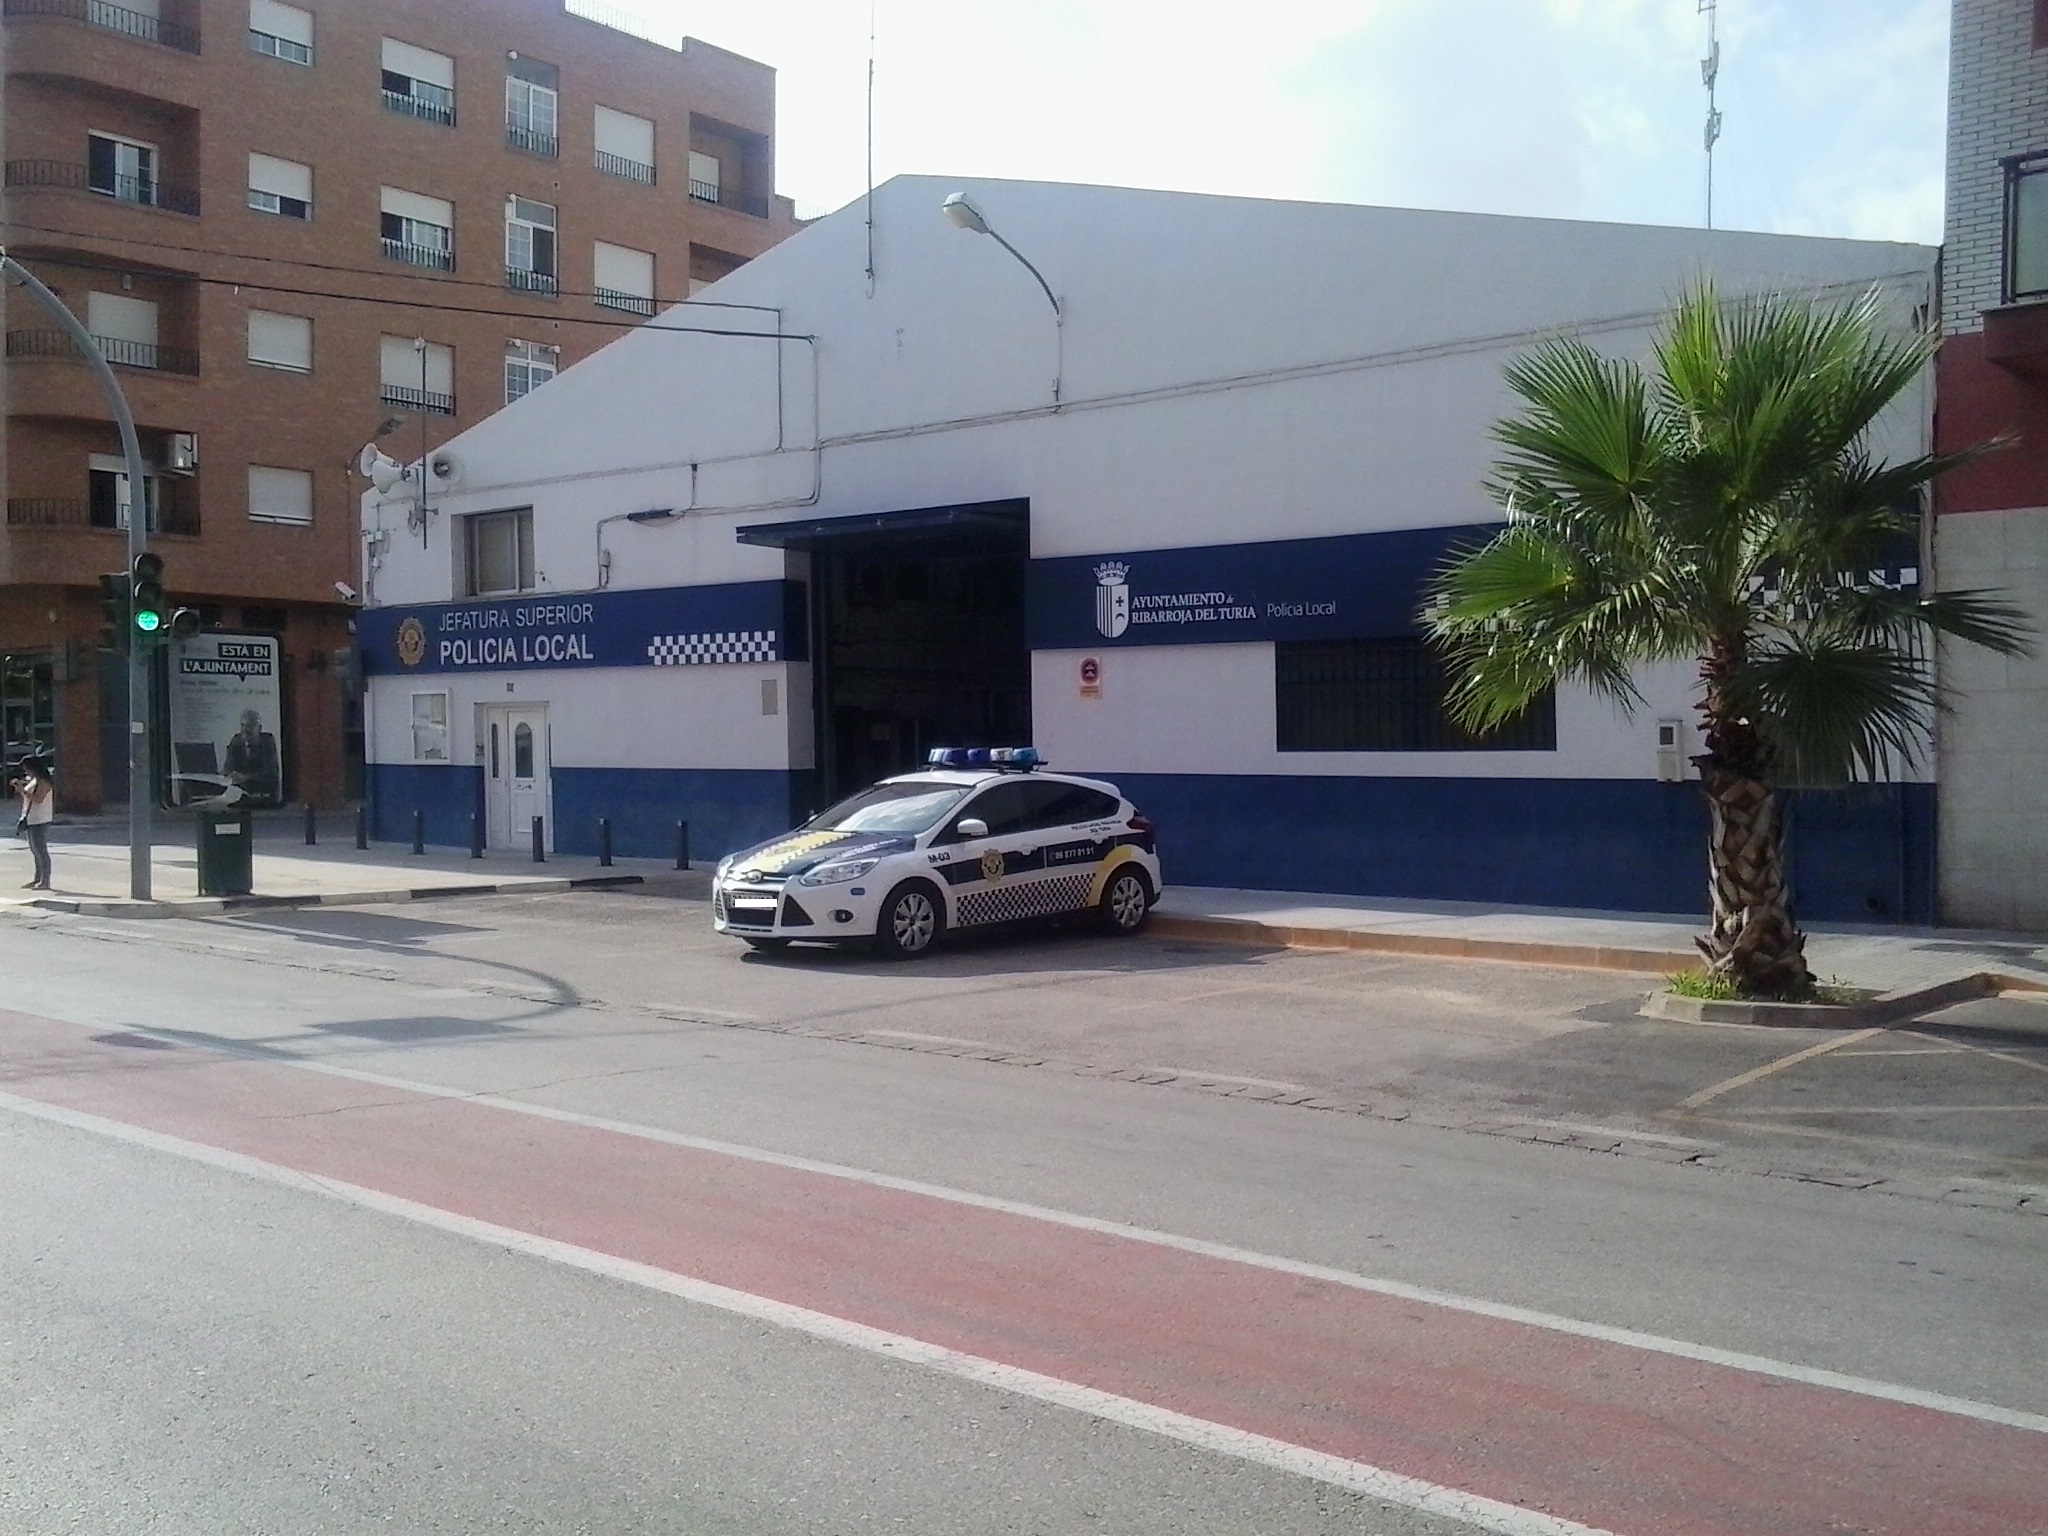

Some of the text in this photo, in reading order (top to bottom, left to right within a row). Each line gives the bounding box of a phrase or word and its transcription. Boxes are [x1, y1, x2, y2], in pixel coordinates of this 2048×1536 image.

[1131, 592, 1225, 608] AYUNTAMIENTO
[1305, 600, 1337, 616] Local
[439, 603, 593, 631] JEFATURA SUPERIOR
[1131, 605, 1257, 625] RIBARROJA DEL TURIA
[253, 646, 268, 657] EN
[440, 633, 594, 665] POLICIA LOCAL
[183, 660, 269, 674] L'AJUNTAMENT
[928, 852, 951, 864] M-03
